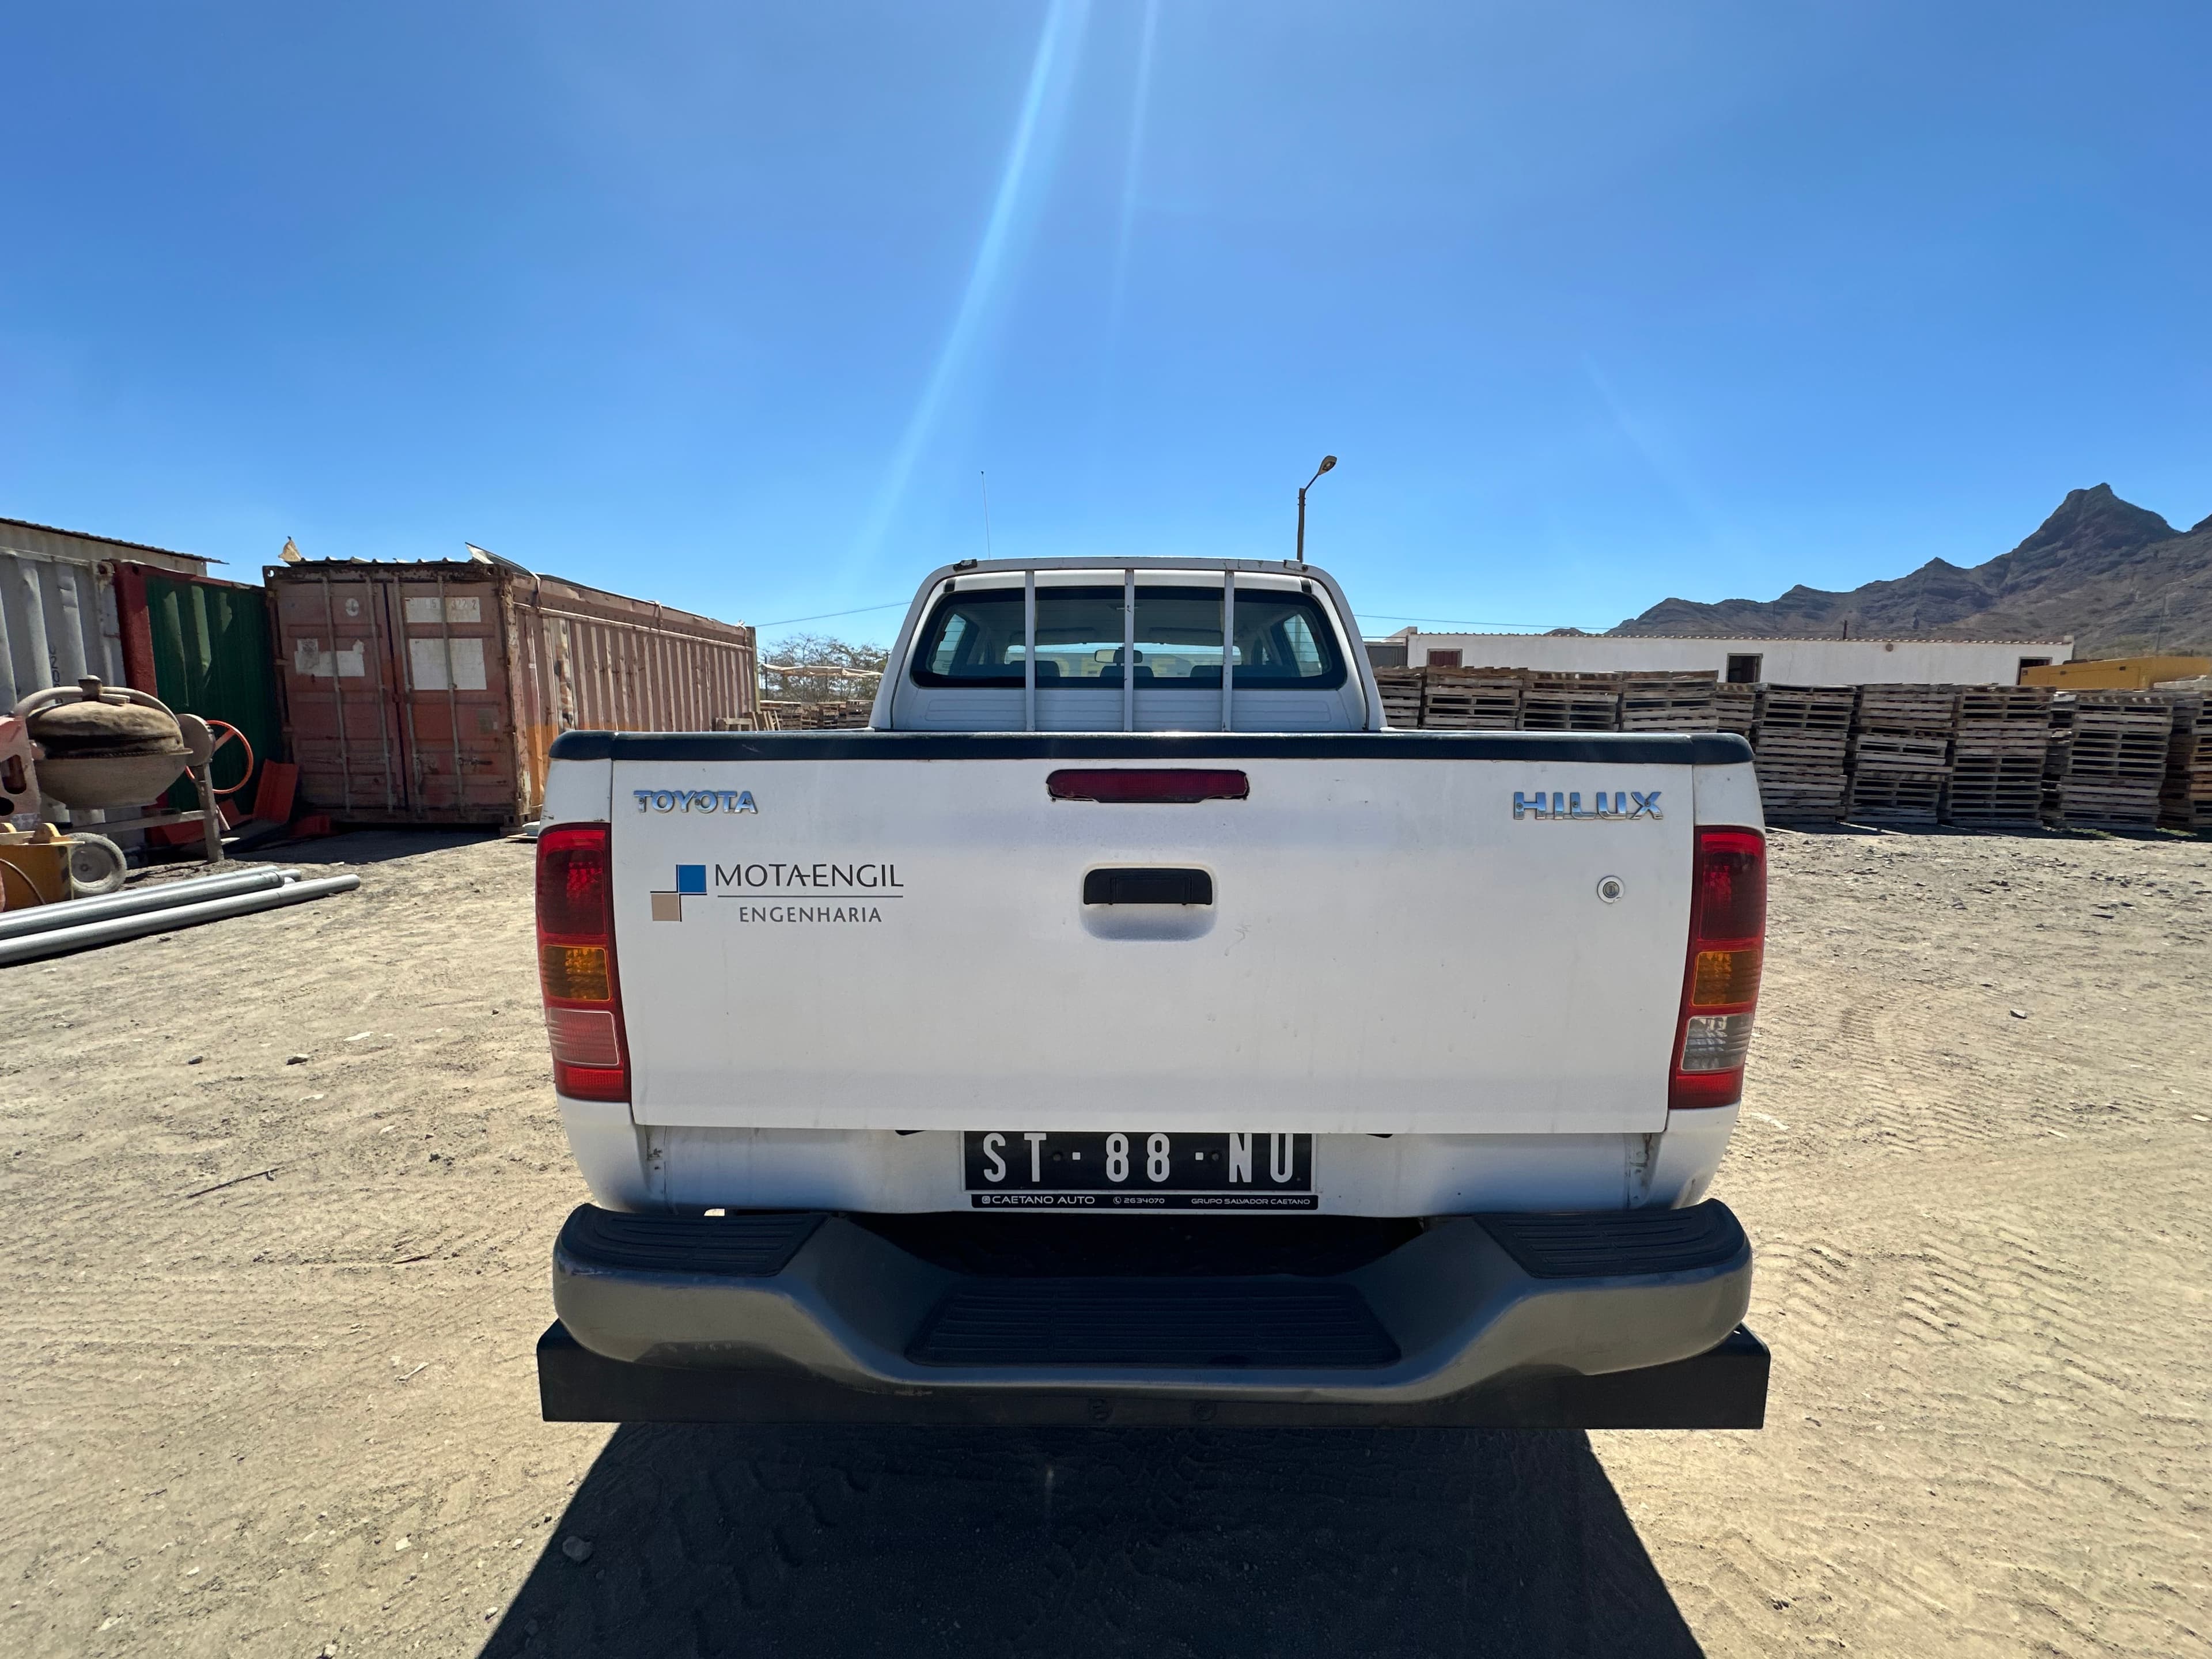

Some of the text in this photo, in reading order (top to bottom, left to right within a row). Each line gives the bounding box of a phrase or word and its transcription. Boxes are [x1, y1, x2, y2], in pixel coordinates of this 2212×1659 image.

[634, 790, 757, 814] TOYOTA
[1513, 791, 1663, 820] HILUX
[739, 906, 882, 923] ENGENHARIA
[983, 1132, 1294, 1183] ST 88 NU
[992, 1196, 1054, 1204] CAETANO
[1057, 1196, 1095, 1204] AUTO
